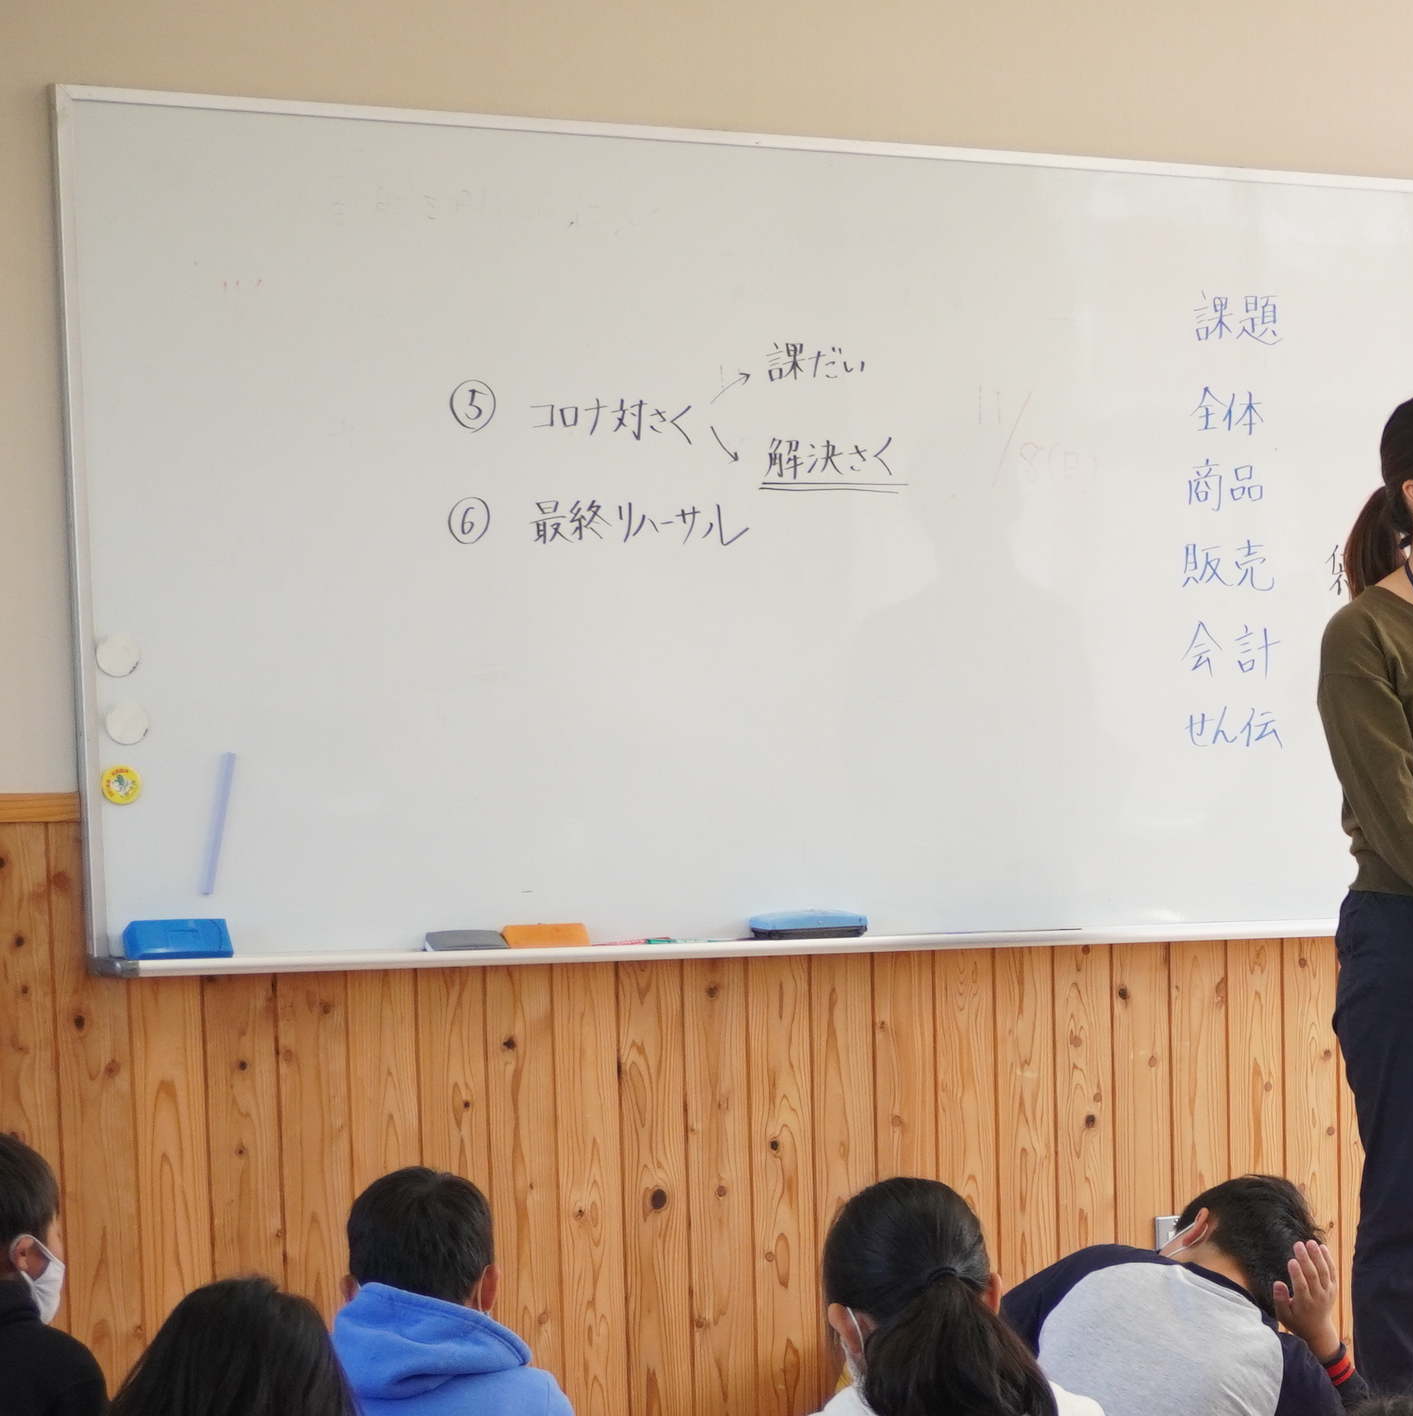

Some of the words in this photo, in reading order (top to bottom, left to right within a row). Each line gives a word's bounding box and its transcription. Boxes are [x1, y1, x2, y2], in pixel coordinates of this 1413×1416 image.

[1193, 290, 1284, 346] 課題
[766, 342, 866, 382] 課だい
[530, 397, 692, 445] コロナ対さく
[1190, 386, 1264, 436] 全体
[764, 436, 893, 480] 解決さく
[1187, 458, 1264, 512] 商品
[529, 500, 750, 547] 最終リハーサル
[1181, 539, 1275, 593] 販売
[1181, 620, 1281, 679] 会計
[1184, 706, 1284, 750] せん伝
